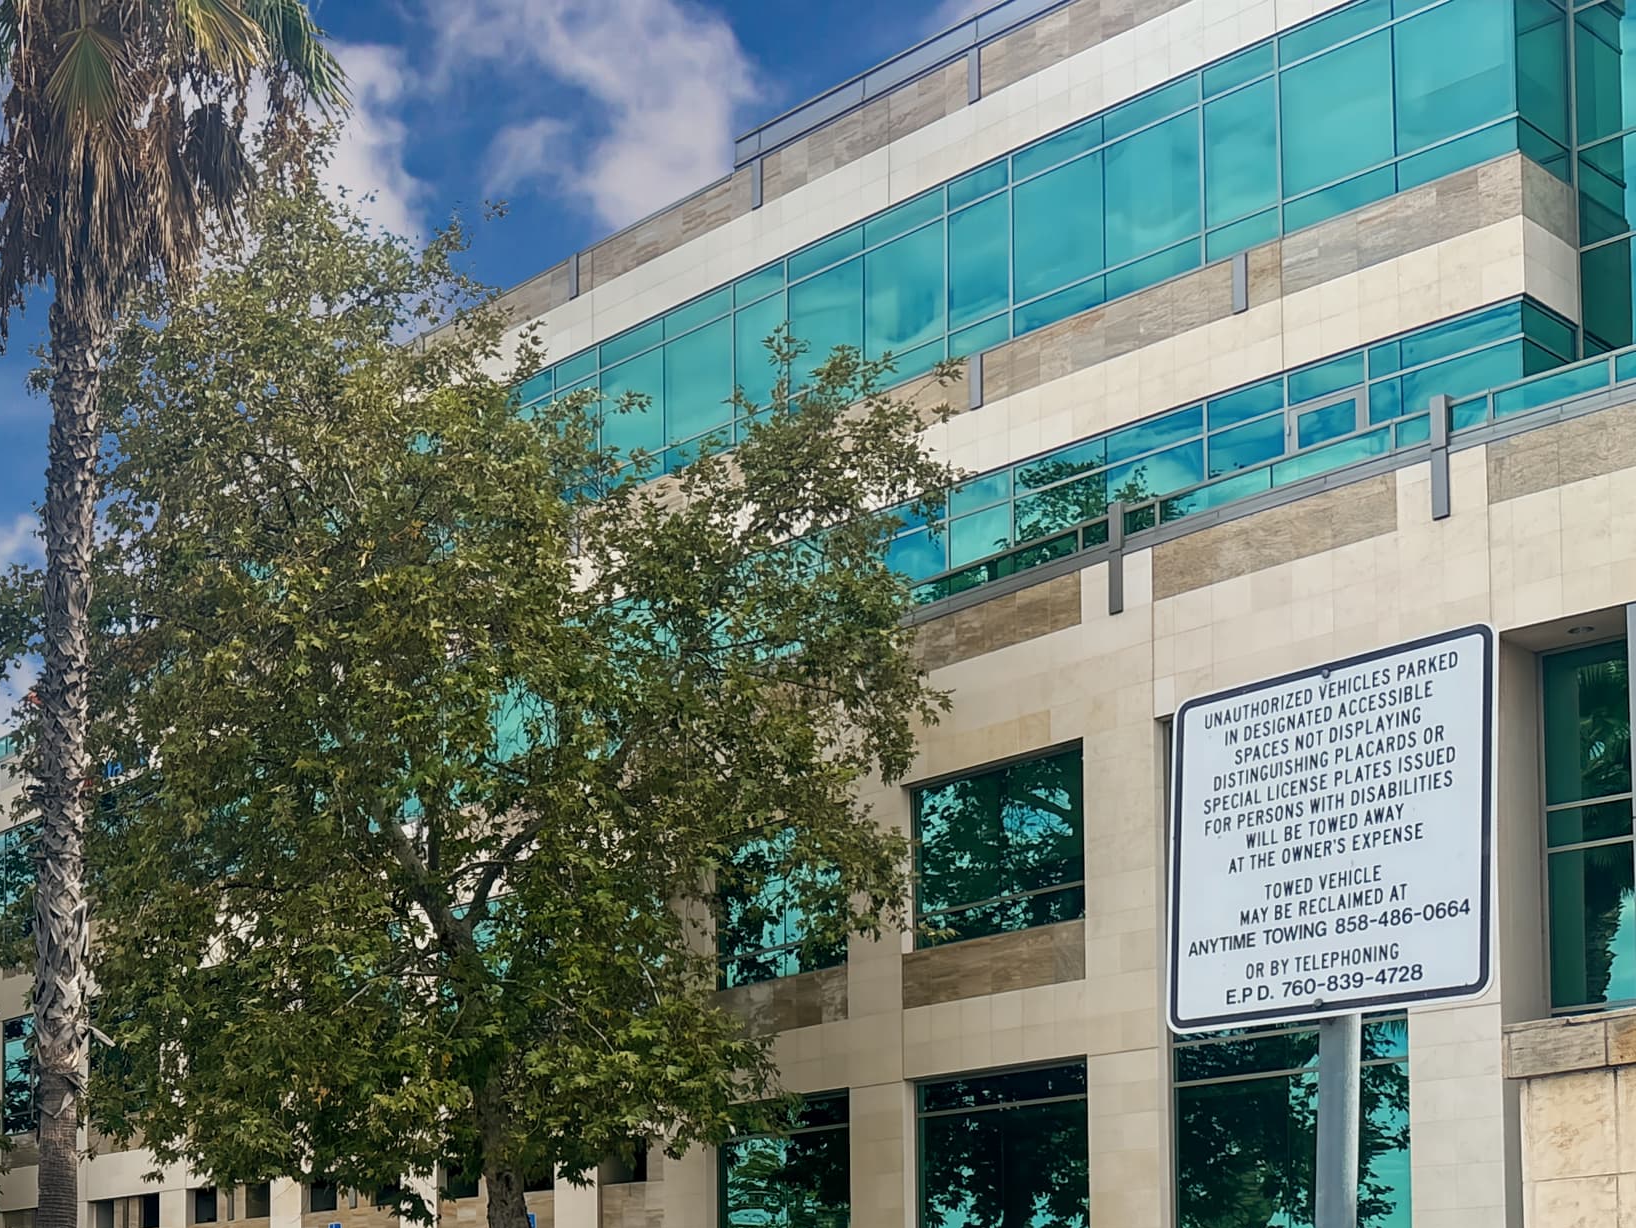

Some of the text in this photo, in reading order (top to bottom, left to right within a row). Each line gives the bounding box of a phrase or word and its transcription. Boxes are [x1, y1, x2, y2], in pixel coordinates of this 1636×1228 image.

[1205, 651, 1458, 729] UNAUTHORIZED VEHICLES PARKED
[1225, 680, 1433, 746] IN DESIGNATED ACCESSIBLE
[1214, 725, 1444, 791] DISTINGUISHING PLACARDS OR
[1235, 707, 1421, 765] SPACES NOT DISPLAYING
[1204, 746, 1455, 815] SPECIAL LICENSE PLATES ISSUED
[1205, 770, 1452, 836] FOR PERSONS WITH DISABILITIES
[1229, 822, 1423, 874] AT THE OWNER'S EXPENSE
[1246, 803, 1404, 849] WILL BE TOWED AWAY
[1240, 883, 1407, 926] MAY BE RECLAIMED AT
[1265, 865, 1381, 900] TOWED VEHICLE
[1188, 898, 1470, 957] ANYTIME TOWING 858-486-0664
[1246, 943, 1399, 979] OR BY TELEPHONING
[1282, 964, 1423, 997] 760-839-4728
